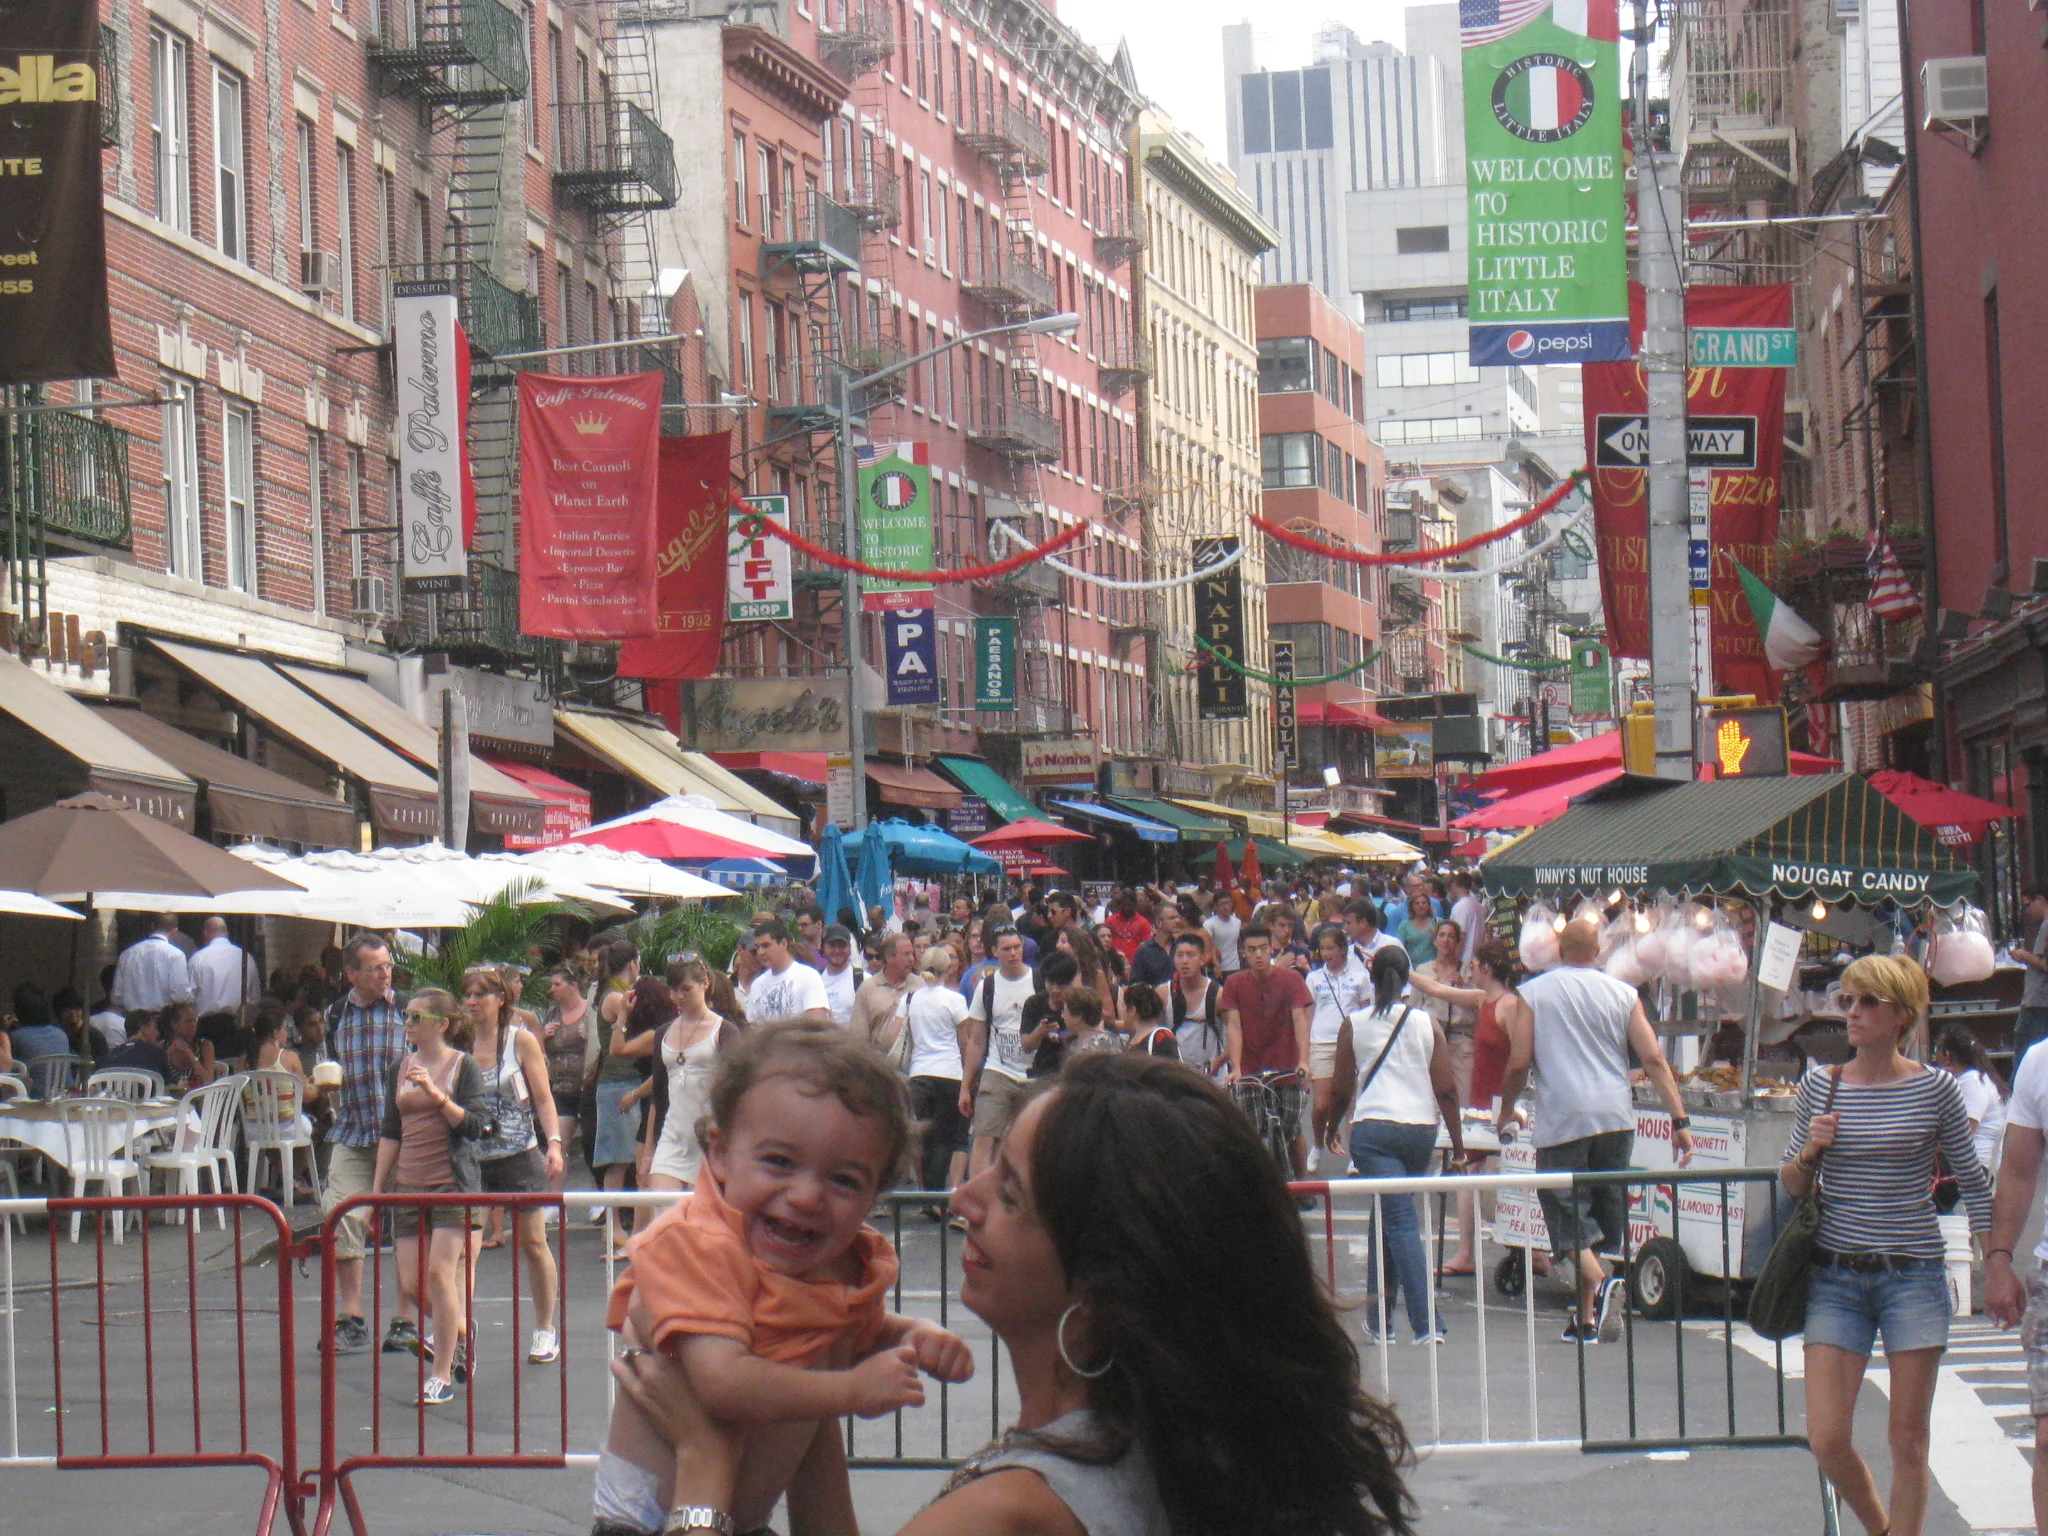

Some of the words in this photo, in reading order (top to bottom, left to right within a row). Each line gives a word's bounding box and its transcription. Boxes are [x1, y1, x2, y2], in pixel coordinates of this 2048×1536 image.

[1506, 55, 1582, 79] HISTORIC
[1494, 102, 1548, 142] LITTLE
[1556, 98, 1593, 140] ITALY
[1472, 156, 1613, 184] WELCOME
[1475, 193, 1507, 216] TO
[1476, 220, 1608, 247] HISTORIC
[1476, 256, 1575, 281] LITTLE
[397, 284, 449, 295] DESSERTS
[1478, 288, 1560, 313] ITALY
[1538, 332, 1592, 352] pepsi
[1693, 332, 1770, 363] GRAND
[1771, 334, 1792, 350] ST
[407, 309, 448, 454] Palermo
[1621, 432, 1648, 451] ON
[1689, 432, 1735, 452] WAY
[552, 459, 578, 472] Best
[582, 459, 631, 473] Cannoli
[581, 481, 598, 490] on
[553, 493, 592, 507] Planet
[596, 494, 629, 507] Earth
[863, 516, 926, 530] WELCOME
[558, 530, 590, 541] Italian
[593, 531, 630, 541] Pastries
[865, 533, 879, 545] TO
[549, 546, 593, 559] Imported
[596, 547, 635, 558] Desserts
[865, 544, 924, 558] HISTORIC
[562, 563, 604, 575] Espresso
[607, 563, 625, 573] Bar
[417, 579, 450, 589] WINE
[579, 580, 604, 590] Pizza
[547, 593, 579, 605] Panini
[582, 595, 637, 606] Sandwiches
[739, 605, 781, 617] SHOP
[681, 614, 712, 628] 1902
[1208, 581, 1233, 703] NAPOLI
[986, 628, 1002, 697] PAESANO'S
[1278, 672, 1294, 757] NAPOLI
[1025, 754, 1042, 767] La
[1044, 753, 1092, 766] Nonna
[1535, 867, 1576, 885] VINNY'S
[1581, 867, 1603, 884] NUT
[1607, 866, 1648, 884] HOUSE
[1772, 863, 1853, 888] NOUGAT
[1862, 872, 1929, 892] CANDY
[1505, 1147, 1529, 1162] CHICK
[1497, 1203, 1522, 1216] HONEY
[1677, 1198, 1713, 1215] ALMOND
[1716, 1202, 1744, 1219] TAST
[1510, 1220, 1546, 1237] PEAUTS
